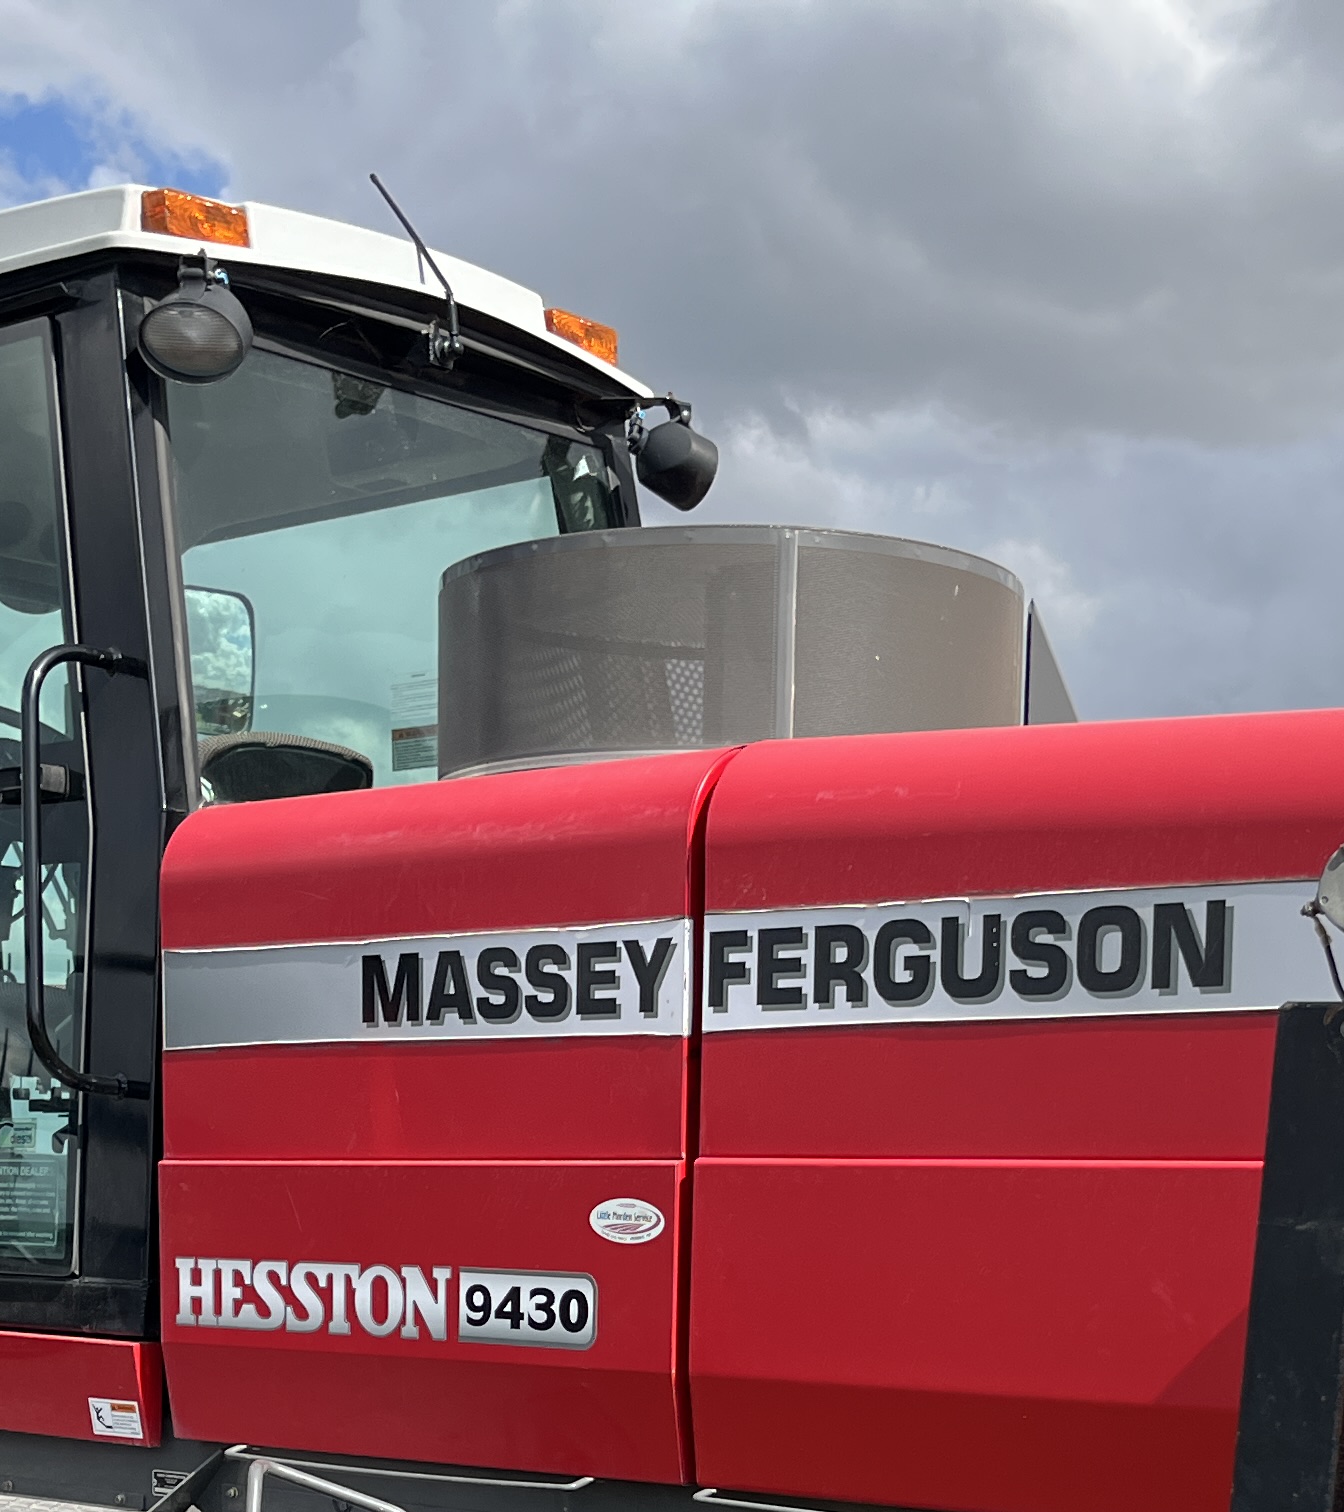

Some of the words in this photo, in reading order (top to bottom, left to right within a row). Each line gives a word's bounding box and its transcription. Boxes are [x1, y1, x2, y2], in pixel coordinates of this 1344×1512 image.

[360, 935, 676, 1026] MASSEY
[707, 898, 1231, 1010] FERGUSON
[173, 1256, 451, 1342] HESSTON
[465, 1283, 589, 1334] 9430
